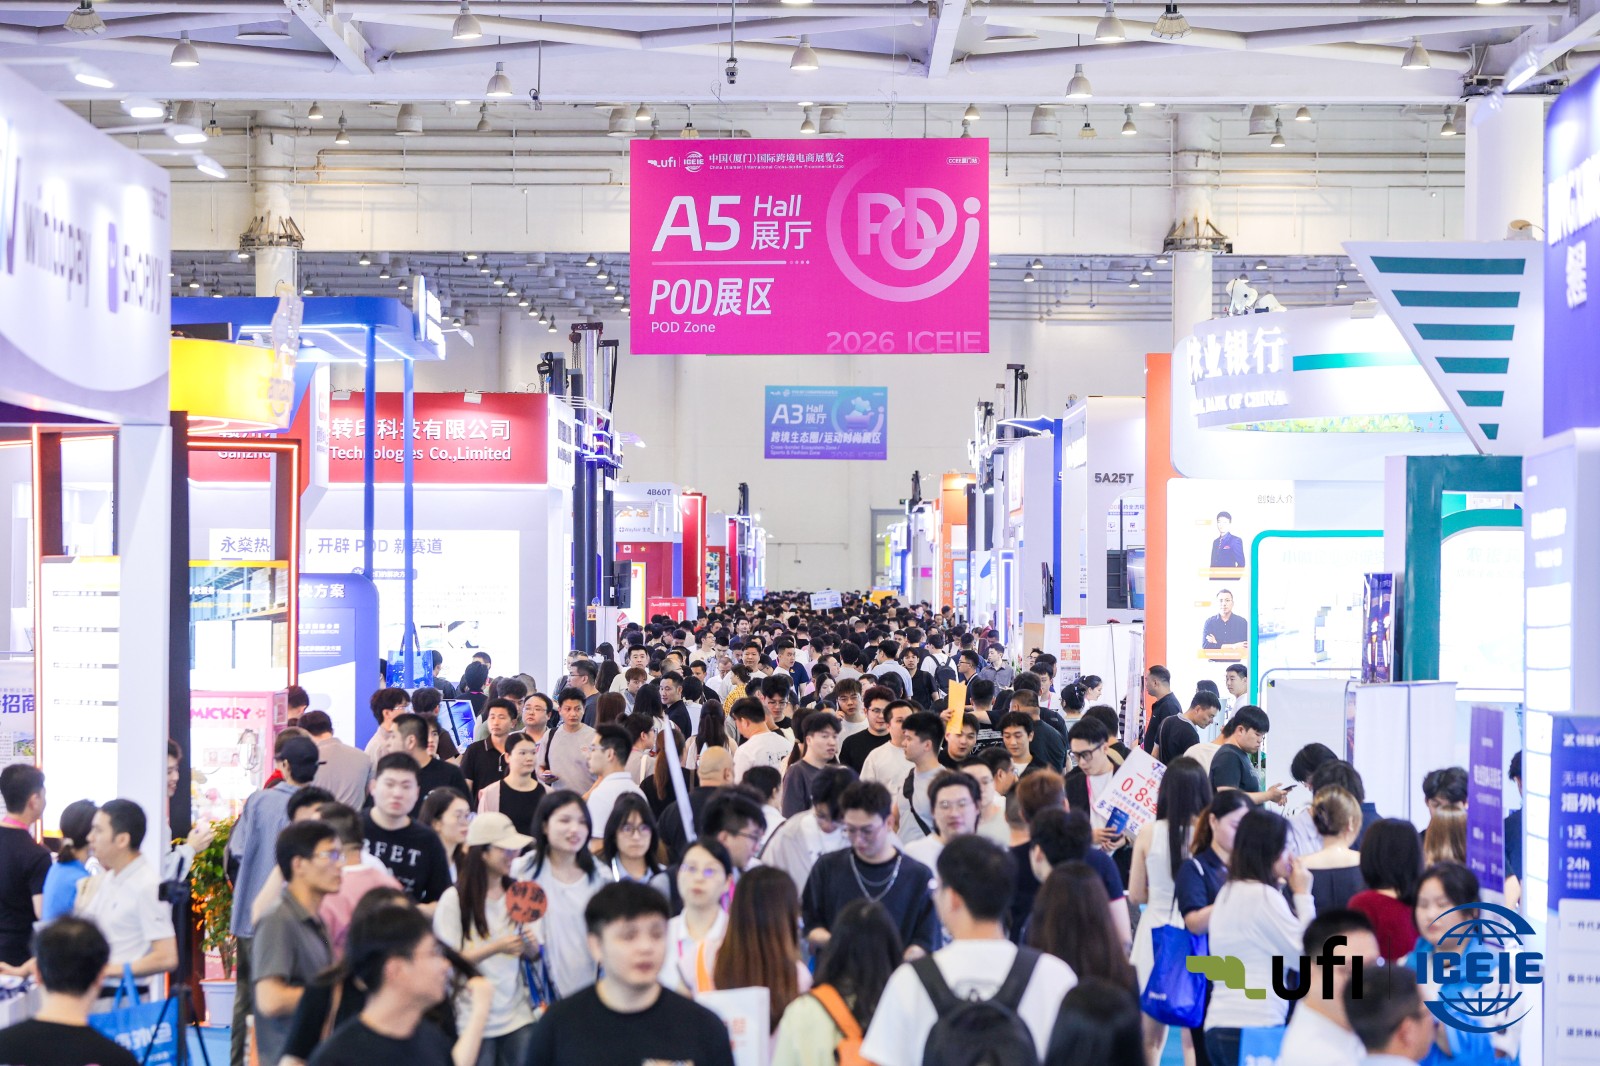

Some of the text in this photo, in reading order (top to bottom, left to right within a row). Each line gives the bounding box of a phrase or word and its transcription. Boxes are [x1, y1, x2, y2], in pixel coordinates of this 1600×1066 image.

[651, 194, 802, 252] A5 Hall
[750, 220, 812, 250] 展厅
[649, 277, 775, 316] POD展区
[651, 321, 716, 333] POD Zone
[826, 331, 982, 353] 2026 ICEIE
[1245, 390, 1289, 407] CHINA
[771, 404, 824, 424] A3 Hall
[805, 413, 827, 424] 展厅
[327, 419, 511, 441] 转印科技有限公司
[331, 446, 424, 463] Techologes
[429, 446, 511, 463] Co.,Limited
[1094, 472, 1134, 484] 5A25T
[646, 488, 672, 497] 4B60T
[190, 707, 252, 721] MICKEY
[1566, 856, 1590, 871] 24h
